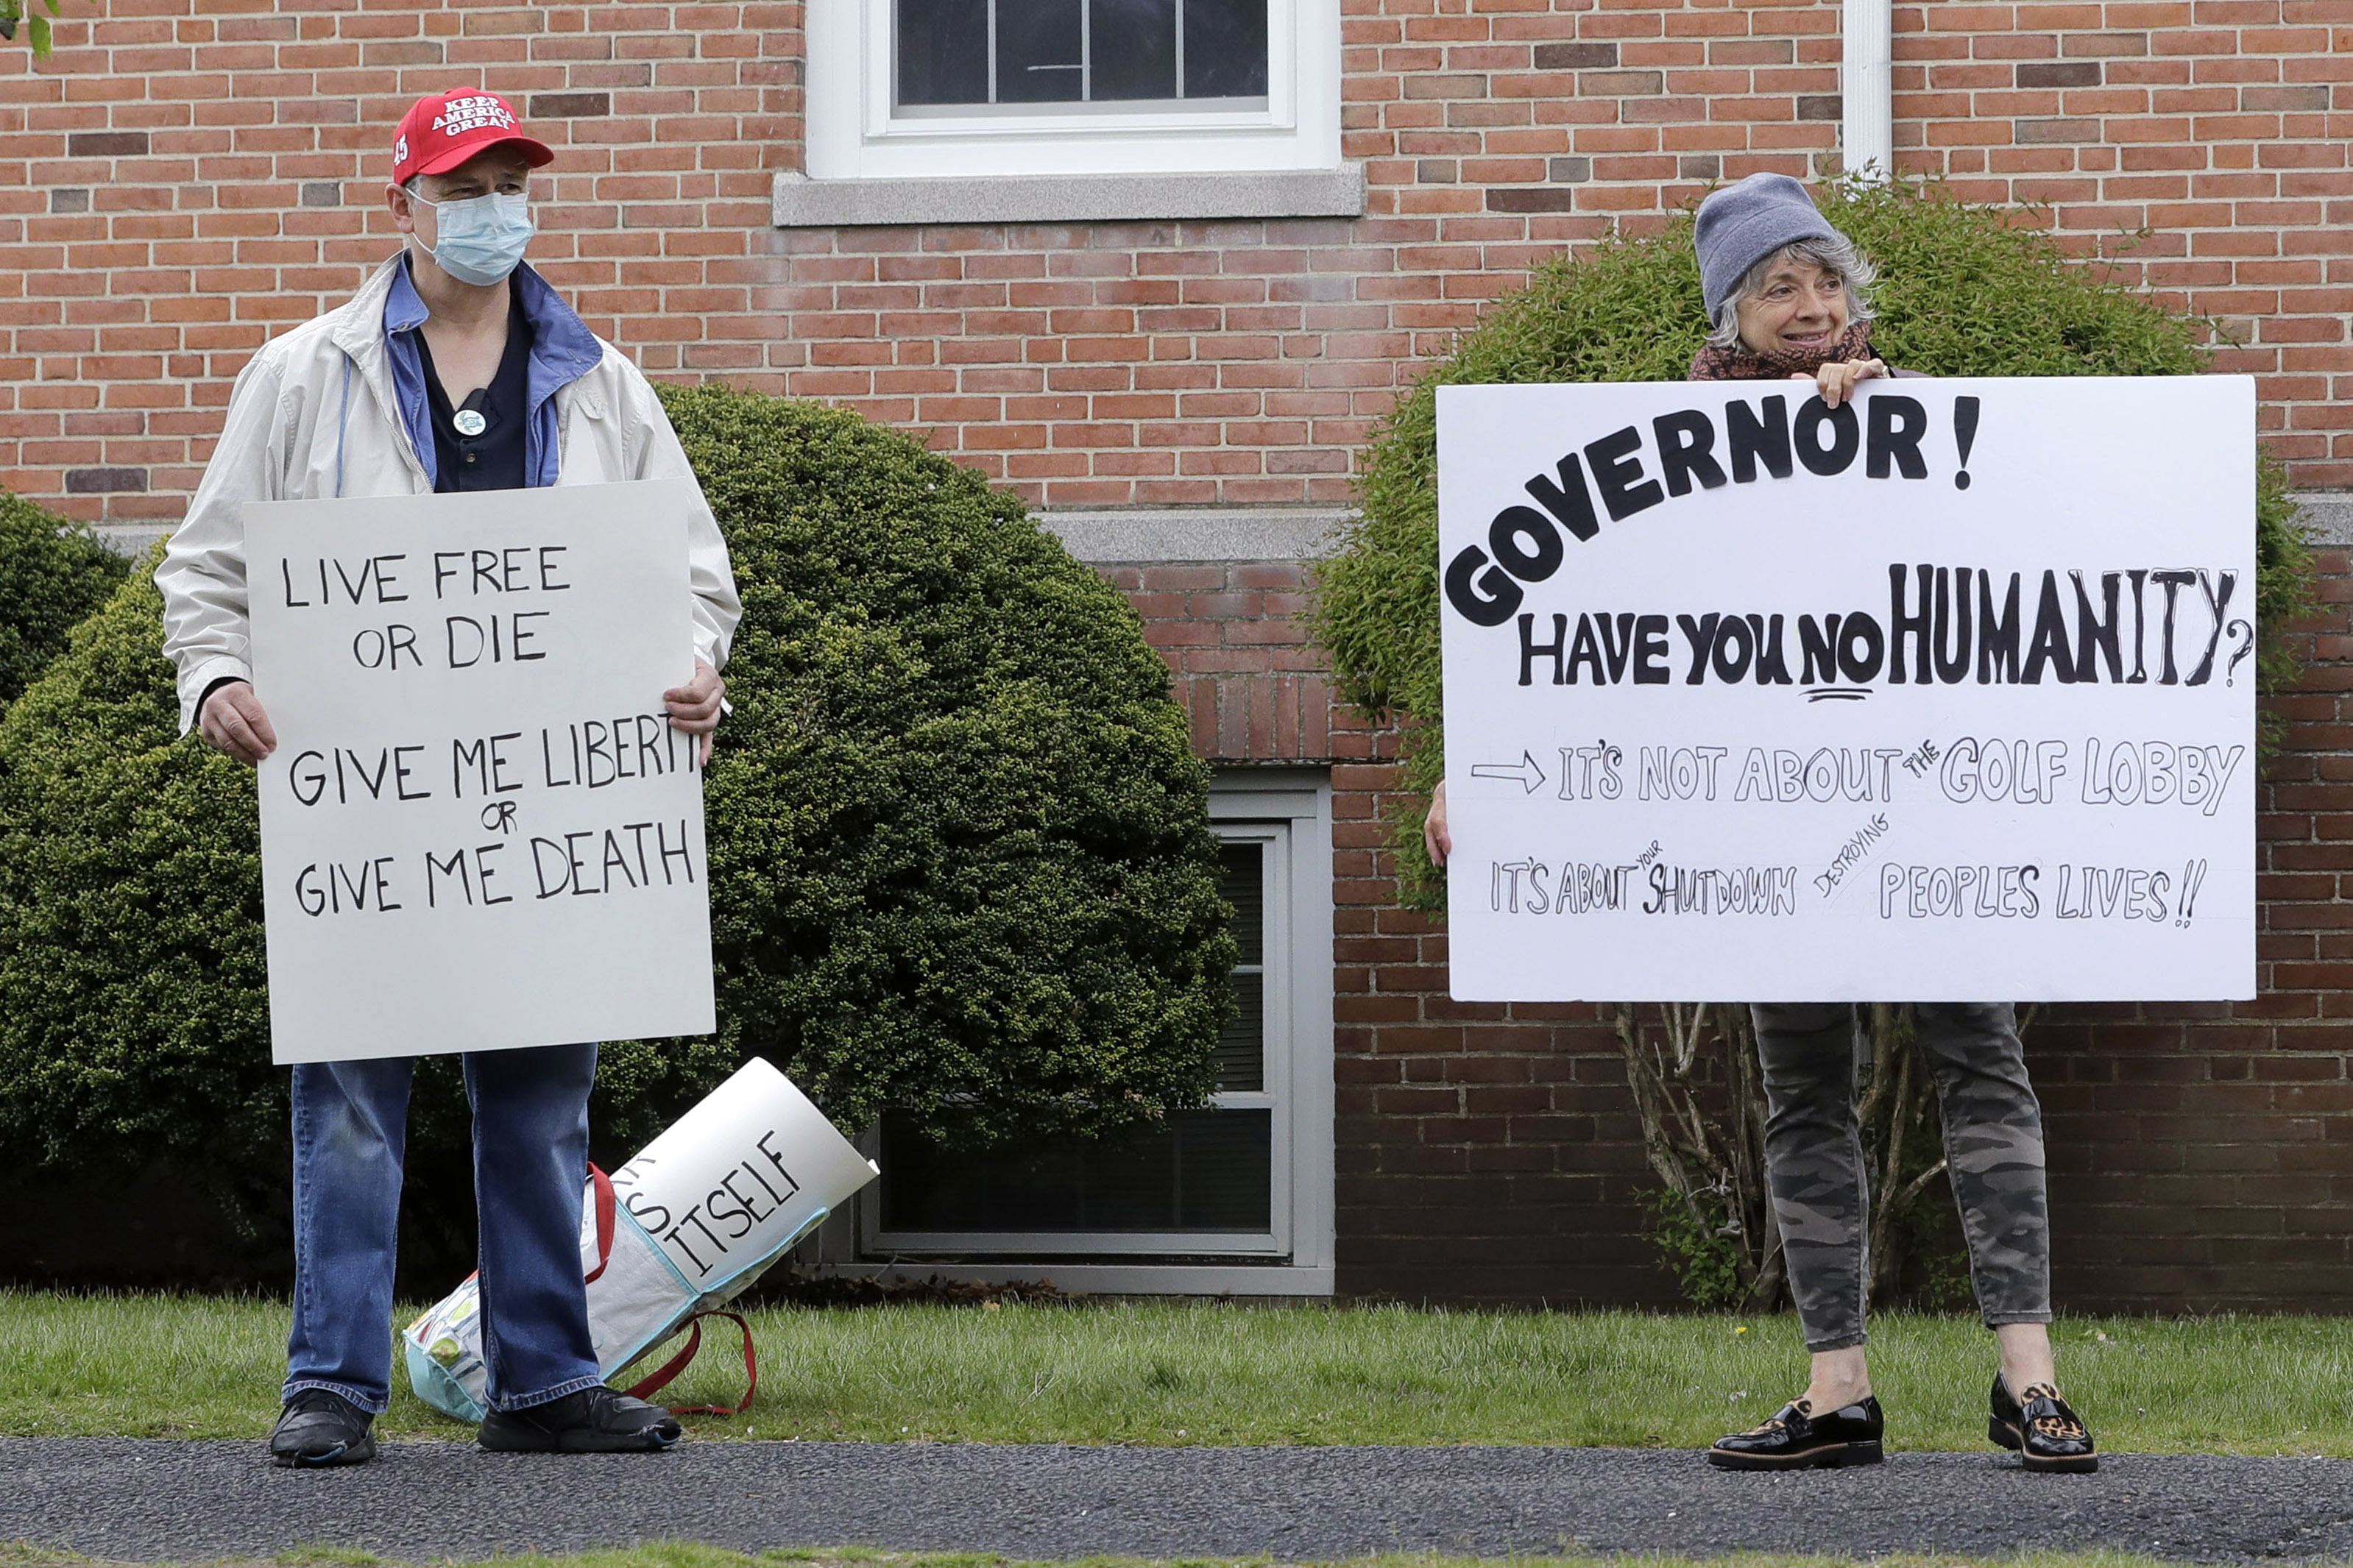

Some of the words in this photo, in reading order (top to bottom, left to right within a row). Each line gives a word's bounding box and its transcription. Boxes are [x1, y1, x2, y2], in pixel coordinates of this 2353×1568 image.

[431, 106, 516, 131] AMERICA
[445, 96, 500, 113] KEEP
[445, 116, 511, 137] GREAT
[1445, 394, 1980, 627] GOVERNOR!
[283, 553, 408, 608] LIVE
[434, 546, 571, 600] FREE
[353, 624, 423, 671] OR
[446, 611, 551, 669] DIE
[1518, 612, 1671, 686] HAVE
[1676, 612, 1794, 686] YOU
[1798, 611, 1885, 686] NO
[1888, 564, 2254, 687] HUMANITY?
[289, 745, 432, 806] GIVE
[453, 732, 523, 798] ME
[1558, 739, 1623, 801] IT'S
[1638, 746, 1728, 801] NOT
[1735, 747, 1903, 803] ABOUT
[1903, 739, 1940, 779] THE
[1940, 737, 2068, 804] GOLF
[2081, 737, 2246, 817] LOBBY
[481, 800, 517, 834] OR
[295, 856, 403, 917] GIVE
[425, 842, 514, 908] ME
[530, 818, 695, 899] DEATH
[1635, 840, 1664, 871] YOUR
[1813, 812, 1889, 898] DESTROYING
[1490, 856, 1549, 915] IT'S
[1555, 862, 1639, 915] ABOUT
[1642, 862, 1797, 916] SHUTDOWN
[1880, 862, 2040, 919] PEOPLES
[2056, 858, 2207, 929] LIVES!!
[662, 1129, 801, 1278] ITSELF
